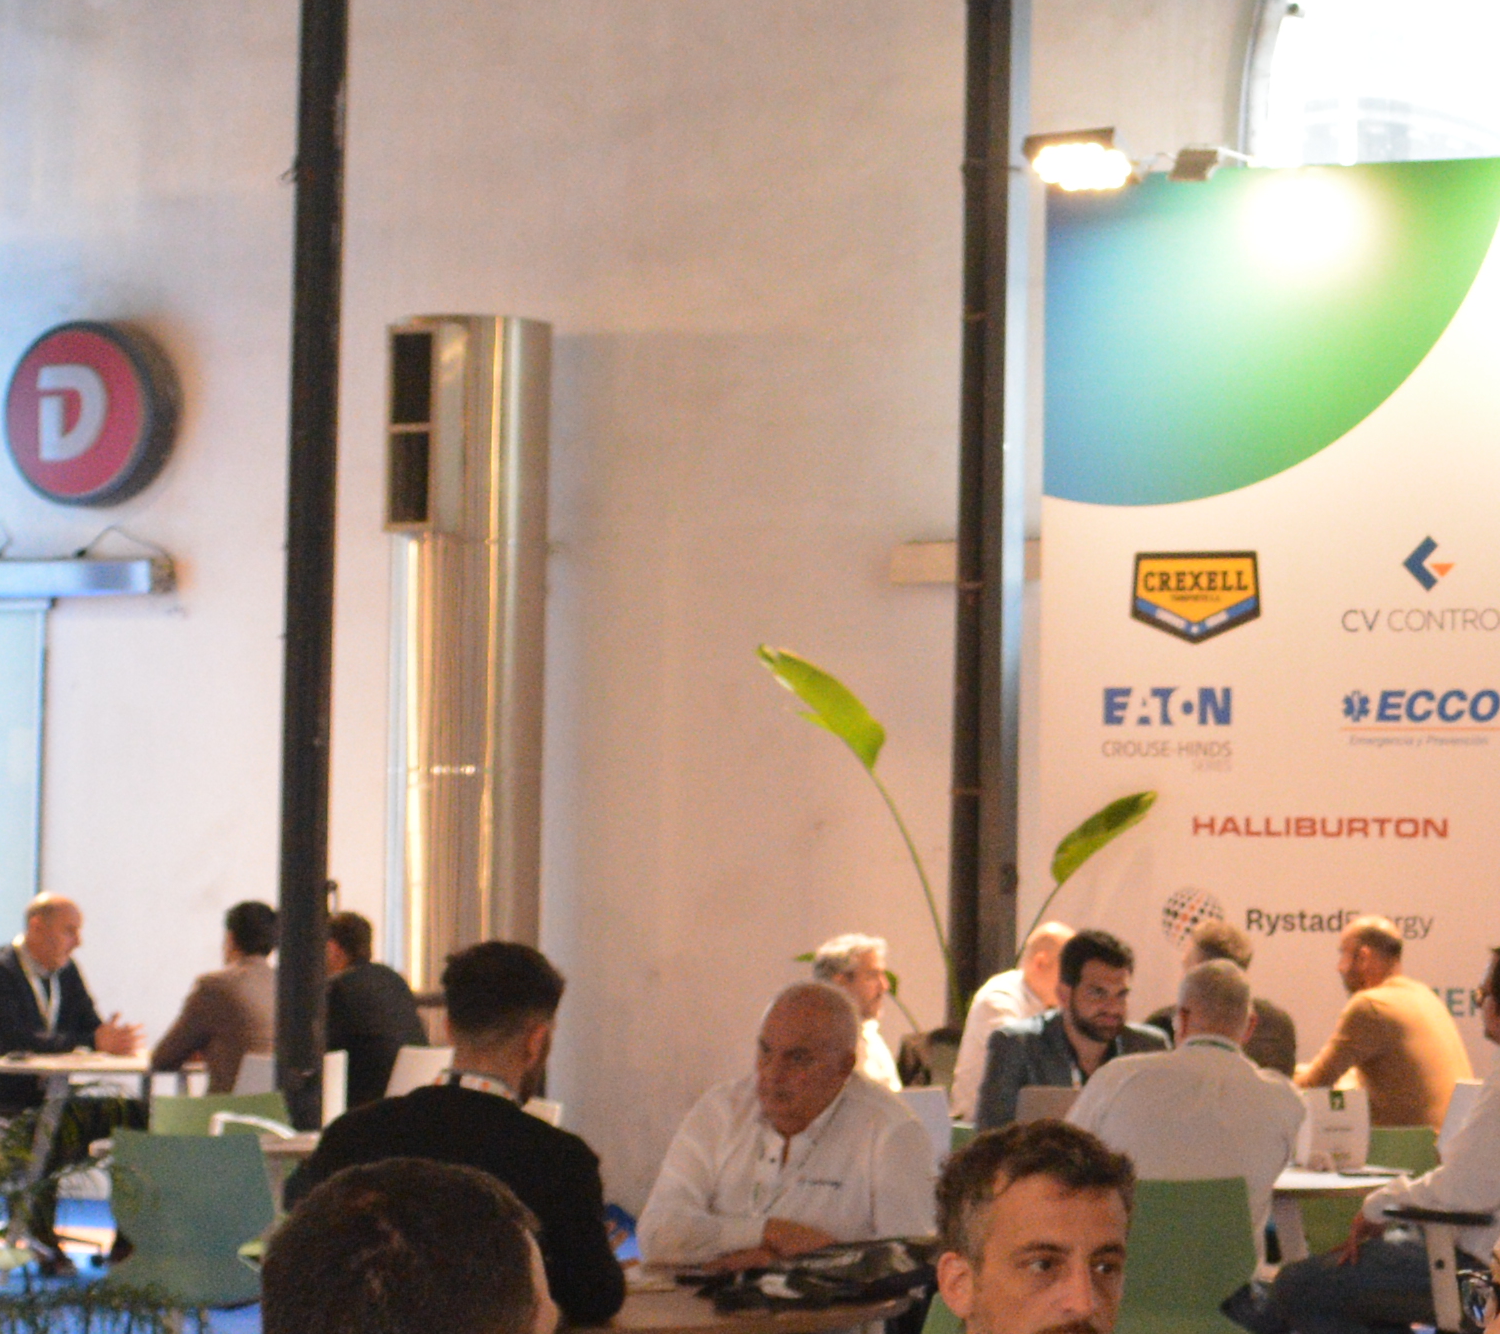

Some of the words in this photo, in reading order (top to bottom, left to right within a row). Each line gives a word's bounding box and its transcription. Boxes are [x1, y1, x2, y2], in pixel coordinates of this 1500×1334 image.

[1143, 569, 1248, 593] CREXELL
[1342, 608, 1380, 633] CV
[1192, 814, 1449, 840] HALLIBURTON
